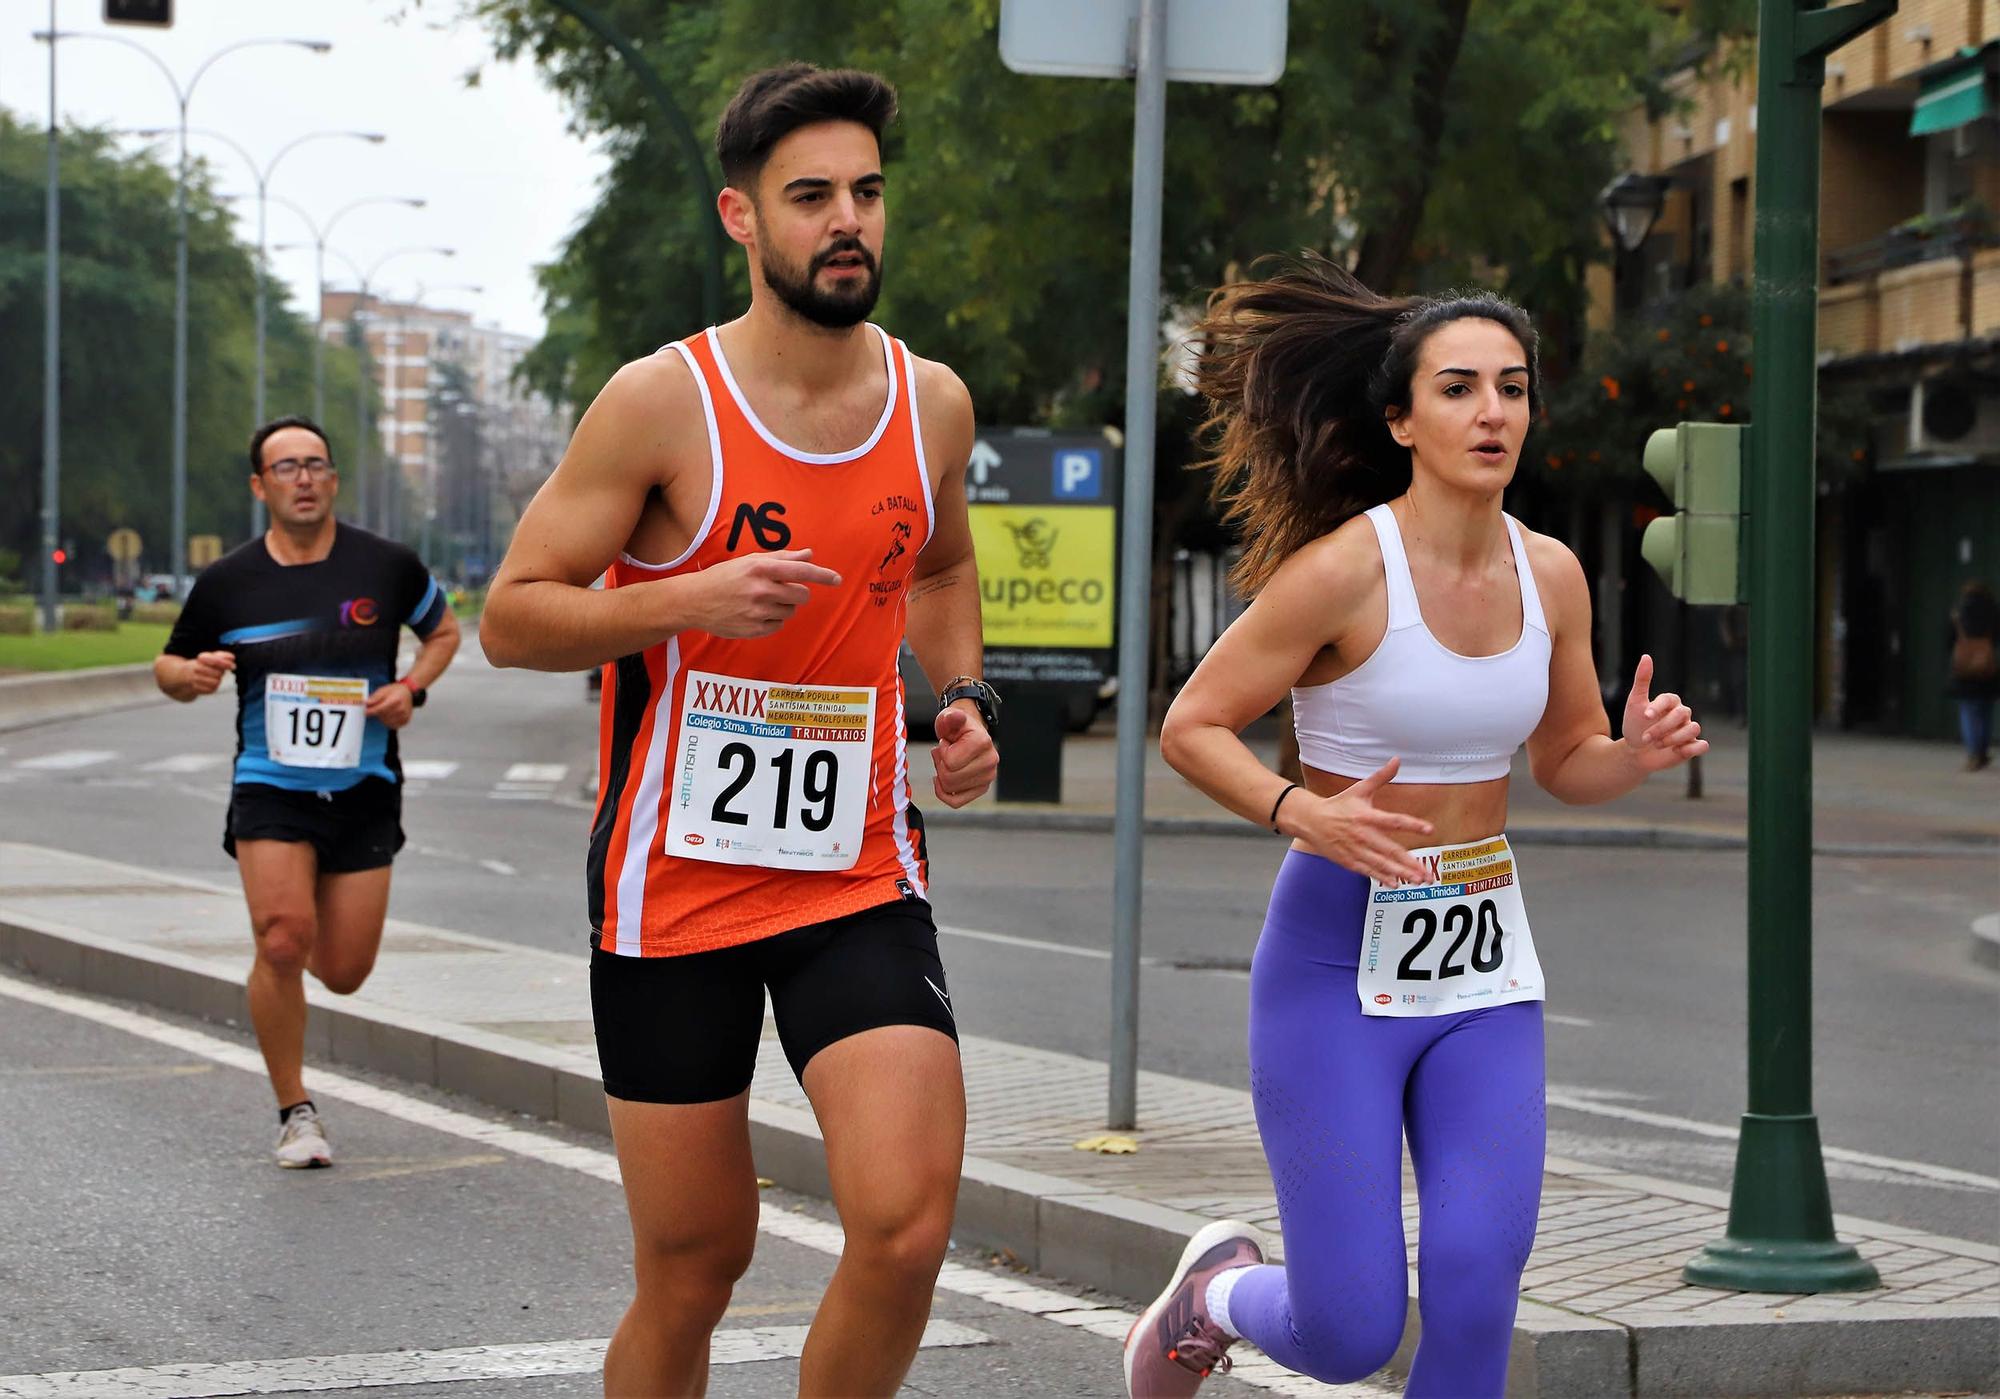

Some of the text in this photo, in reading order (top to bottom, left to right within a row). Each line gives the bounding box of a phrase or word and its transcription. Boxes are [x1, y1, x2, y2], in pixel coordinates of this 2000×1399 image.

[1062, 454, 1091, 492] P
[982, 577, 1104, 611] upeco
[692, 680, 768, 718] XXXIX
[770, 688, 840, 701] CARRERA POPULAR
[767, 711, 806, 722] MEMORIAL
[813, 704, 846, 713] TRINIDAD
[289, 708, 347, 748] 197
[688, 714, 786, 738] Colegio Stma. Trinidad
[795, 728, 866, 741] TRINITARIOS
[711, 742, 839, 832] 219
[1442, 848, 1471, 860] CARRERA
[1375, 885, 1460, 903] Colegio Stma. Trinidad
[1468, 873, 1513, 894] TRINITARIOS
[1397, 899, 1504, 980] 220
